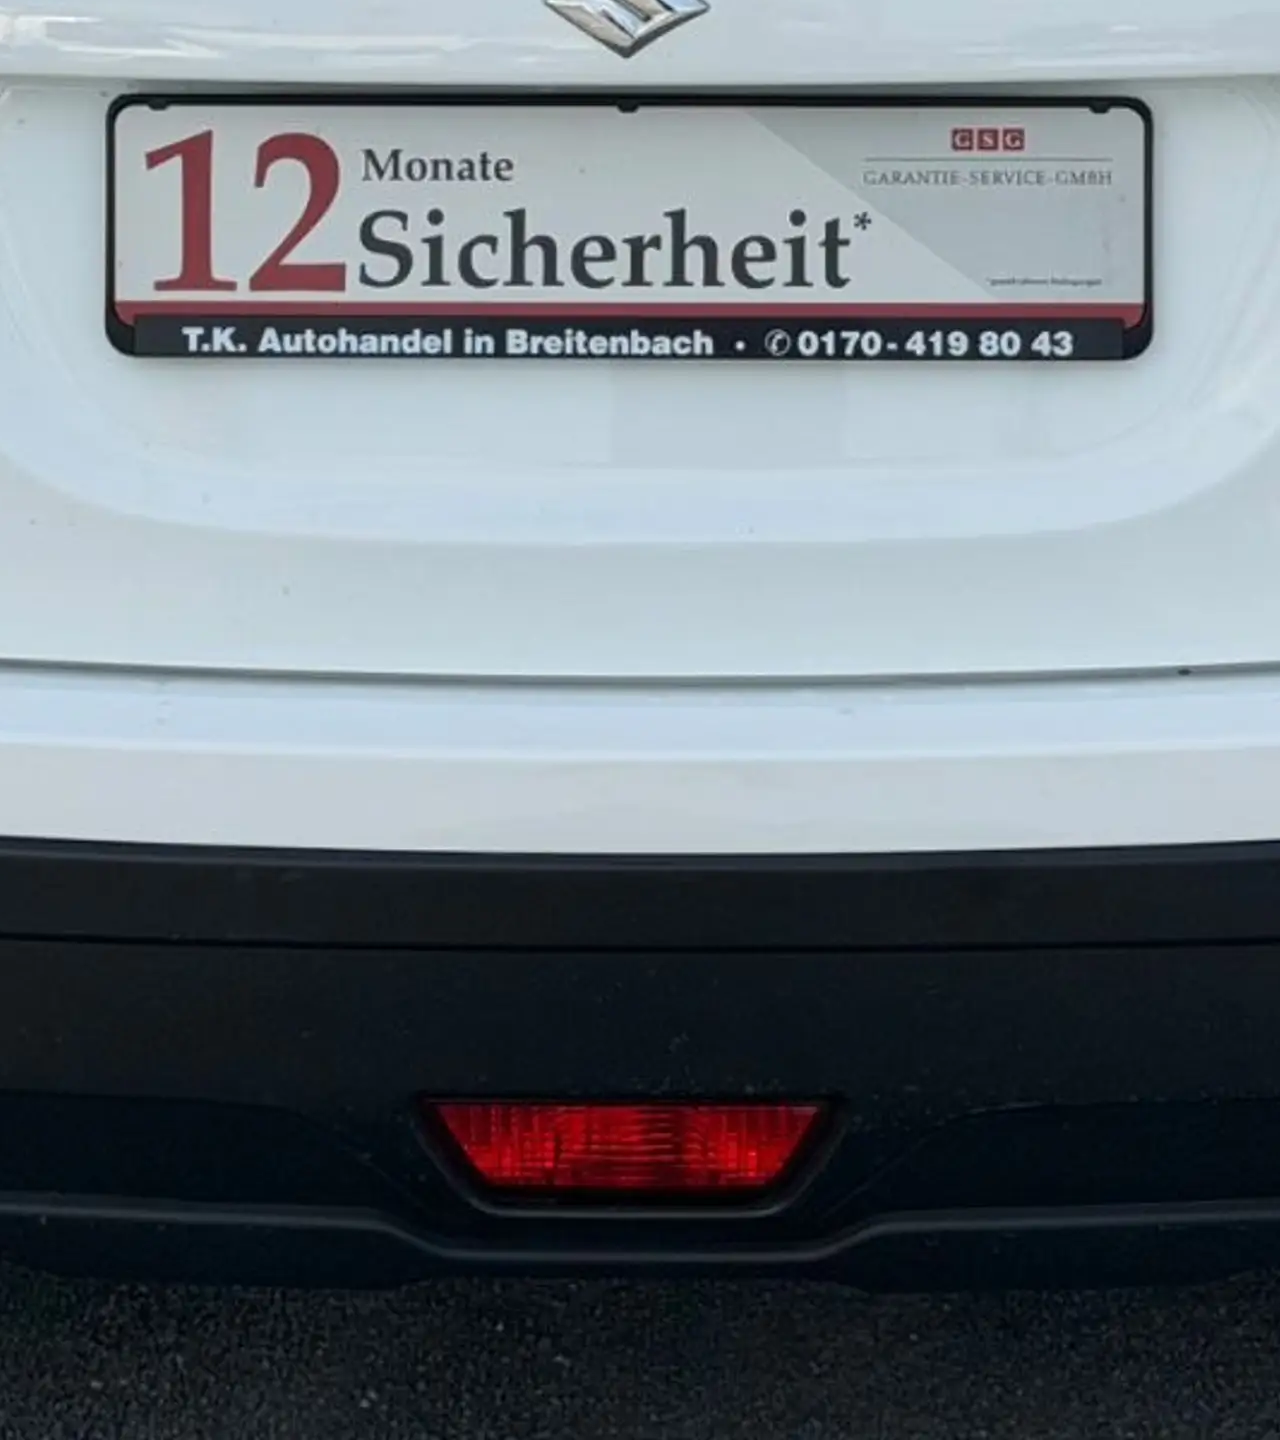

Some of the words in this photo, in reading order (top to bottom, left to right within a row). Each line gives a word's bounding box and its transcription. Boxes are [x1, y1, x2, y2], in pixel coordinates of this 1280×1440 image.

[952, 128, 1024, 151] GSG
[361, 148, 515, 182] Monate
[145, 130, 346, 292] 12
[182, 326, 247, 353] T.K.
[258, 327, 452, 354] Autohandel
[463, 329, 495, 355] in
[506, 329, 714, 356] Breitenbach
[978, 331, 1021, 357] 80
[1030, 331, 1074, 357] 43
